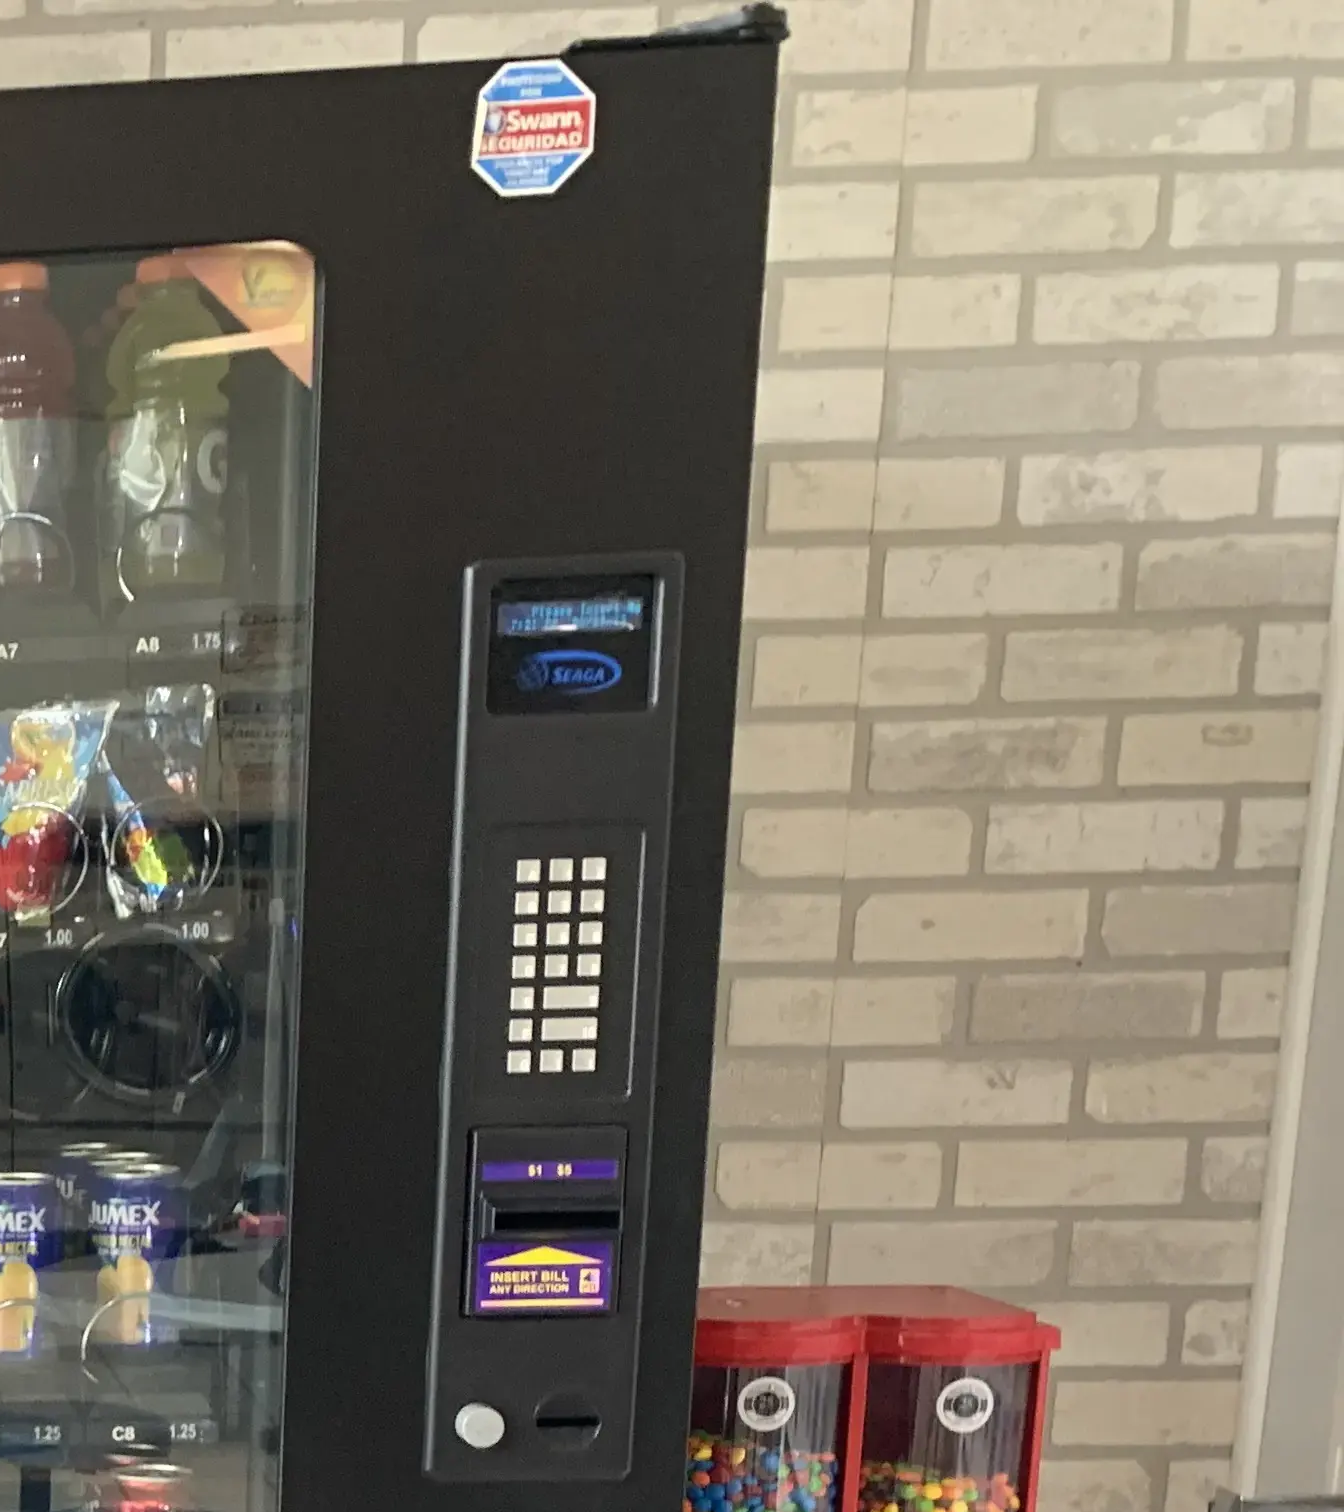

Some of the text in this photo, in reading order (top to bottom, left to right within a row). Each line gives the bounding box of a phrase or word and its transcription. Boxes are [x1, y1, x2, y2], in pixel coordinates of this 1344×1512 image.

[507, 110, 581, 132] Swann
[192, 633, 221, 650] 1.75
[553, 667, 607, 684] SEAGA
[46, 930, 72, 947] 1.00
[182, 923, 209, 939] 1.00
[528, 1164, 542, 1177] $1
[89, 1200, 161, 1225] JUMEX
[490, 1269, 569, 1283] INSERT BILL
[489, 1282, 569, 1294] ANY DIRECTION
[33, 1426, 62, 1442] 1.25
[112, 1424, 196, 1442] C8 1.25
